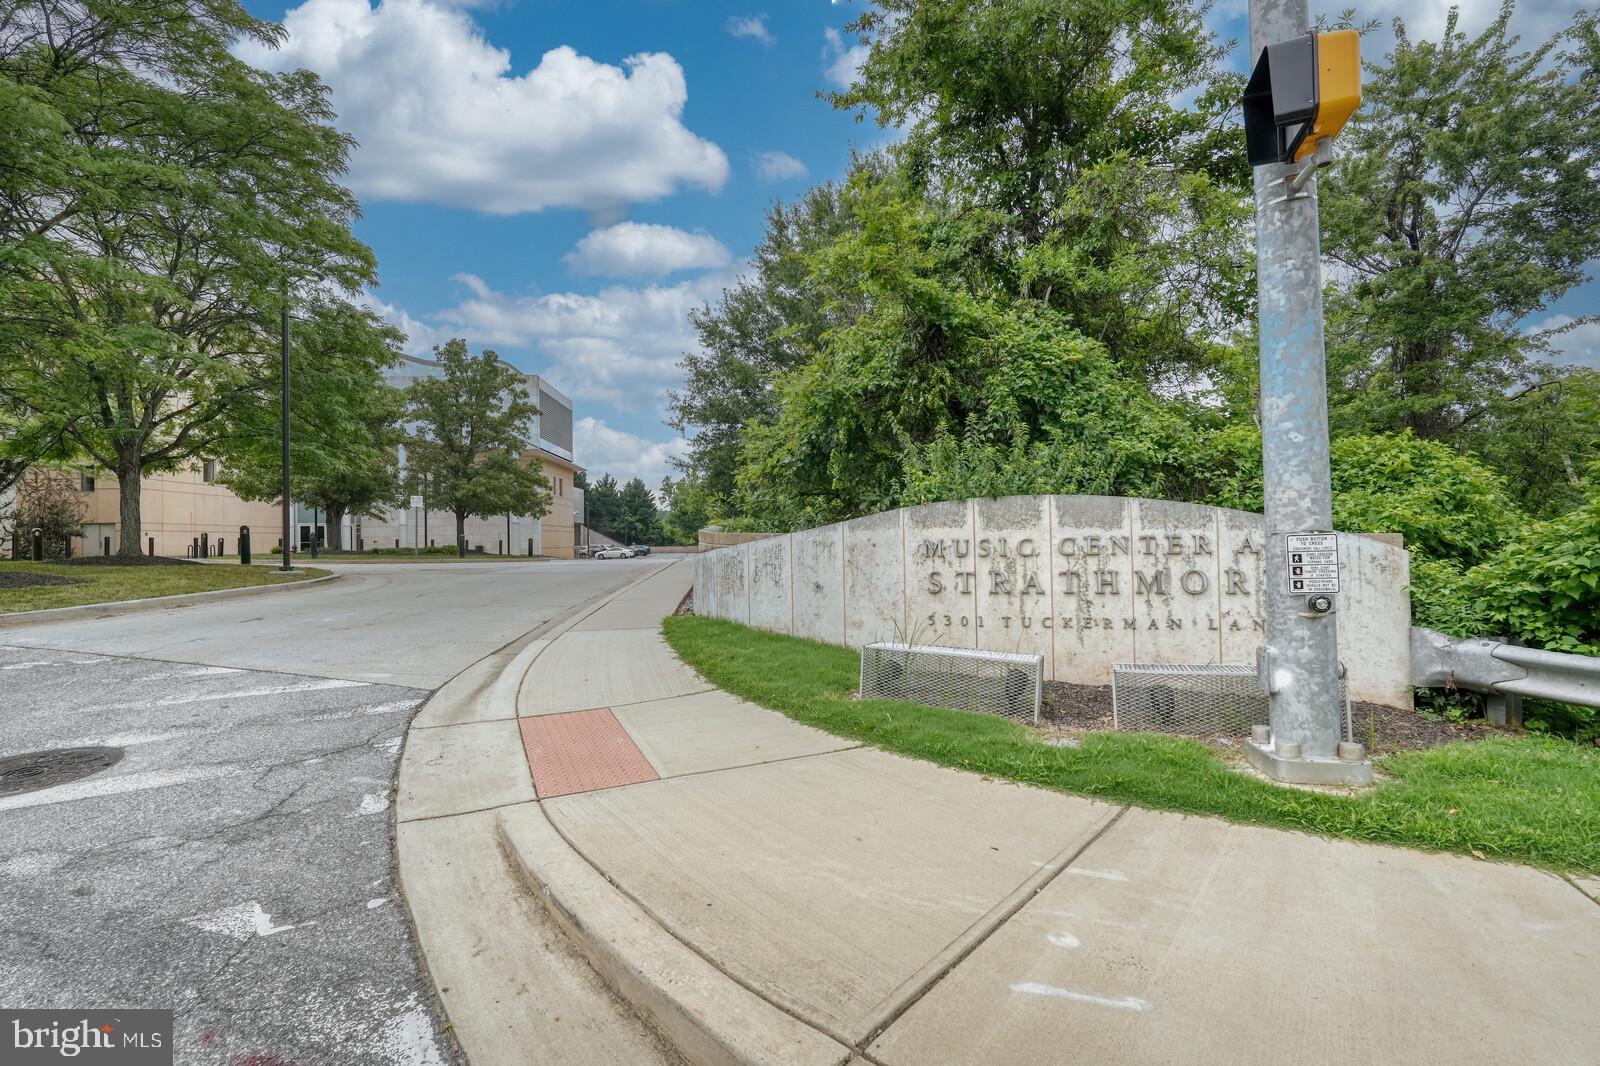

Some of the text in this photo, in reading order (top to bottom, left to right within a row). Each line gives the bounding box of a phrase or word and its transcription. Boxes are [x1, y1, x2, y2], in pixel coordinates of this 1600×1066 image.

[924, 534, 1259, 559] MUSIC CENTER A
[927, 568, 1250, 595] STRATHMOR
[927, 615, 1266, 634] 5301 TUCKERMAN LAN
